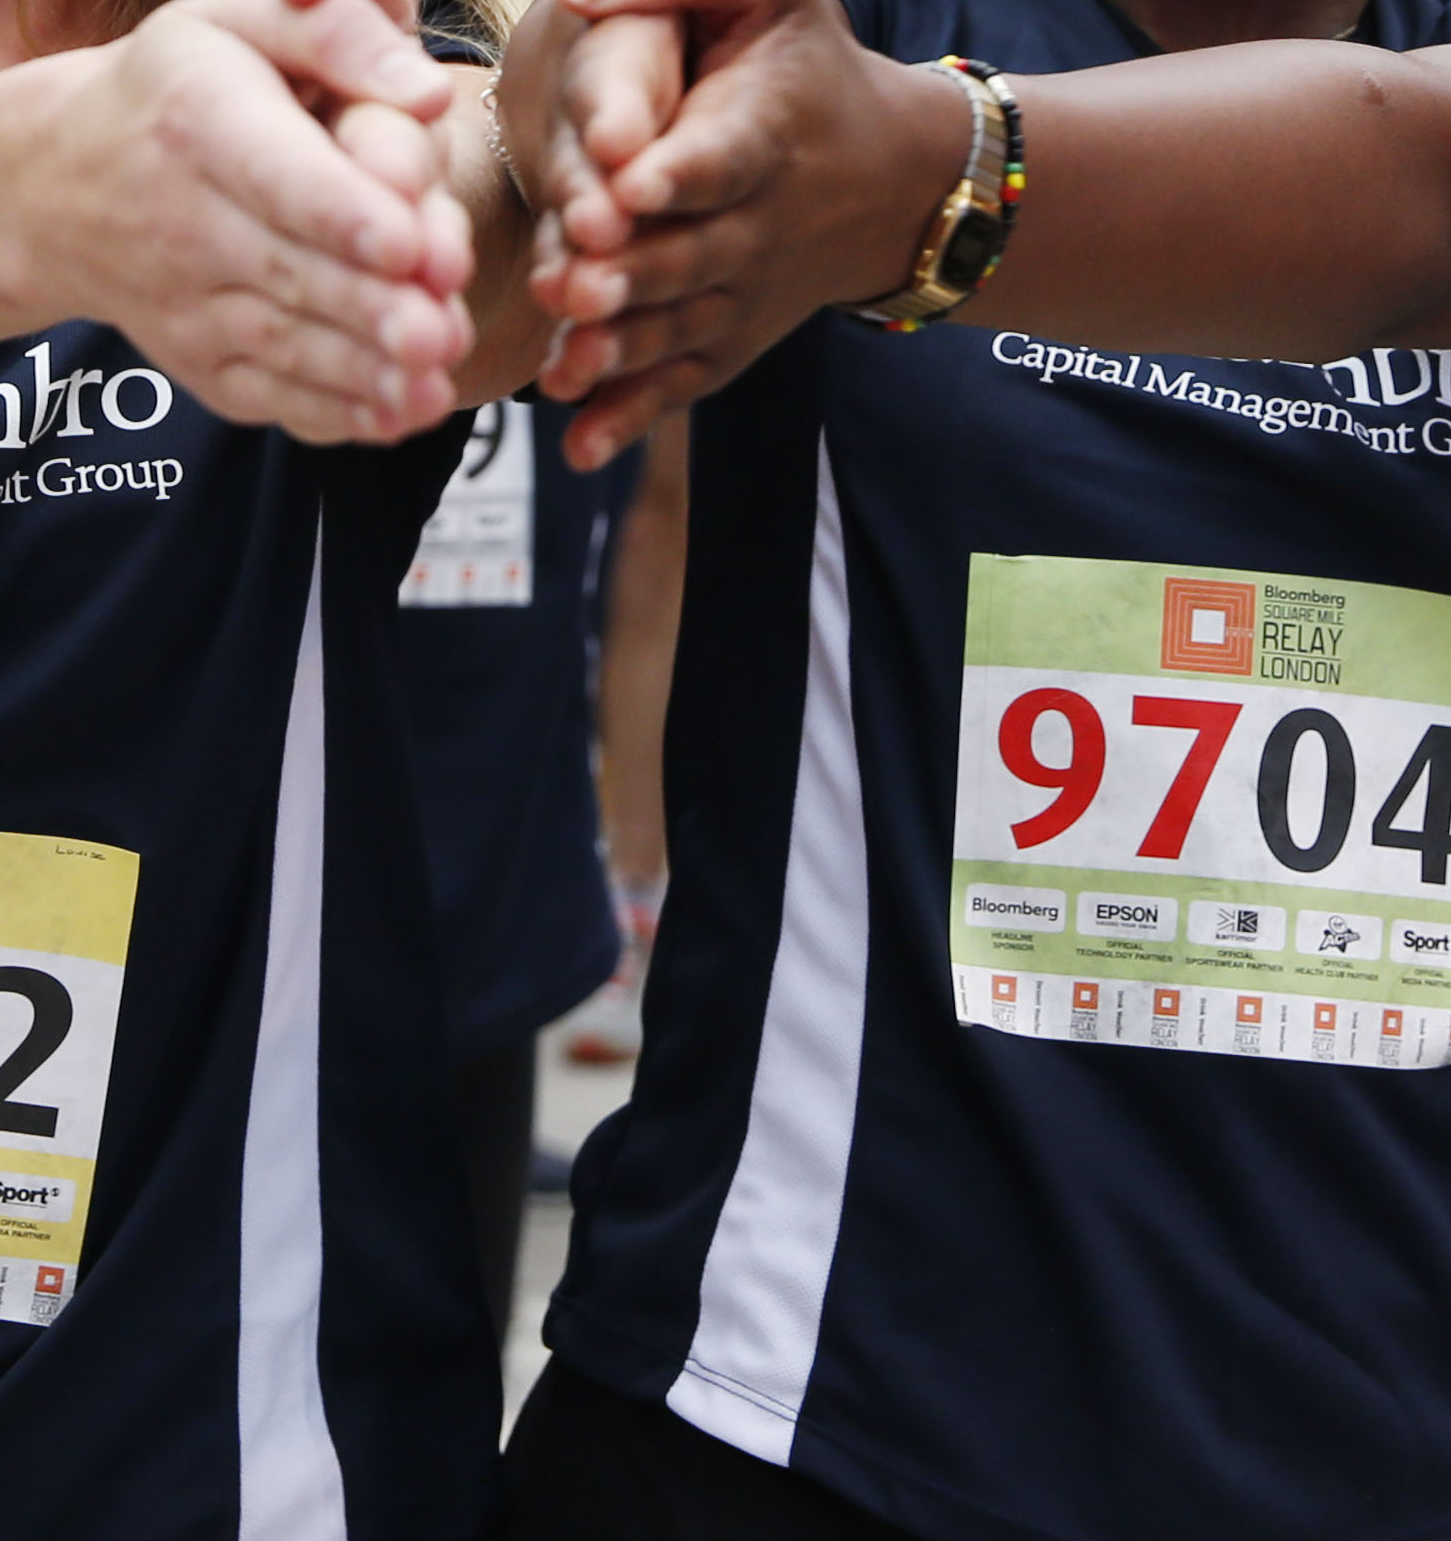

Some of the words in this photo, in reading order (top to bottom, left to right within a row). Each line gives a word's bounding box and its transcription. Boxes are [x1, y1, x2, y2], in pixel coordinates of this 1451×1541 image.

[990, 329, 1145, 384] Capital
[1146, 362, 1416, 454] Management
[35, 457, 184, 500] Group
[1264, 585, 1346, 609] Bloomberg
[1263, 604, 1314, 623] SQUARE
[1317, 610, 1345, 626] MILE
[1262, 621, 1343, 656] RELAY
[1260, 655, 1342, 685] LONDON
[972, 897, 1059, 921] Bloomberg
[1096, 904, 1158, 923] EPSON
